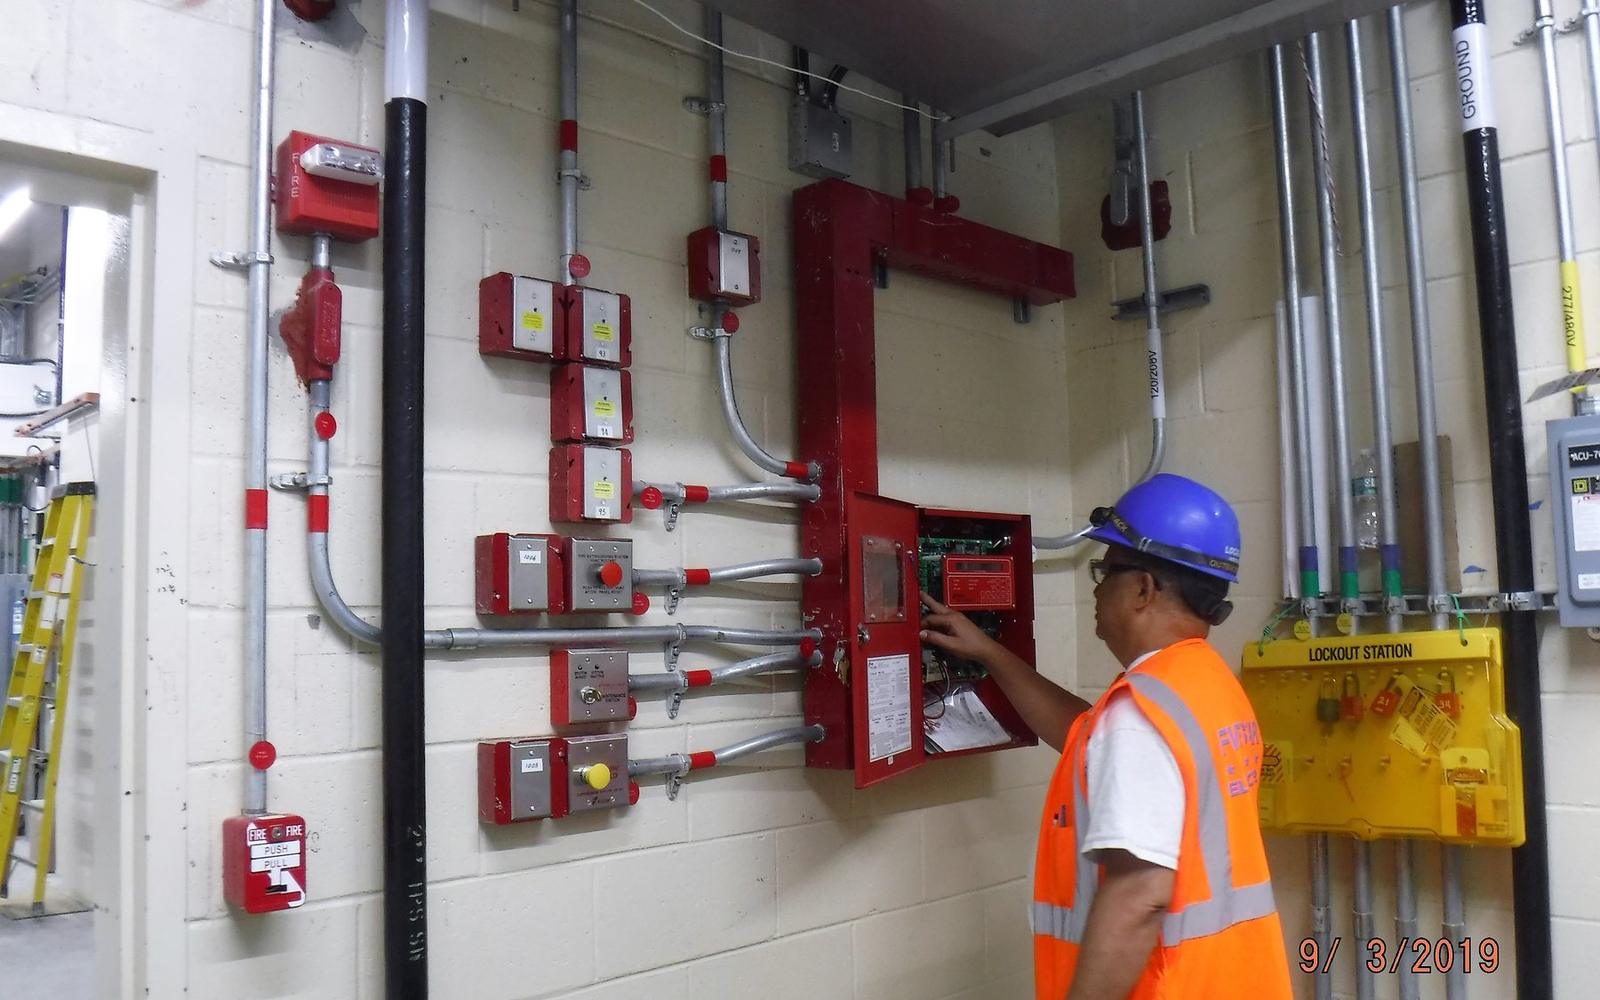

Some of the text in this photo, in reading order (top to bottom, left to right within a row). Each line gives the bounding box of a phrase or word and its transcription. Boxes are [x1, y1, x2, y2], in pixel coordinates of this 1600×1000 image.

[1456, 39, 1476, 119] GROUND
[291, 153, 300, 197] FIRE
[1562, 285, 1576, 347] 277/480V
[1148, 351, 1159, 399] 120/208V
[1573, 450, 1600, 461] ACU-7
[1309, 643, 1413, 662] LOCKOUT STATION
[249, 825, 303, 841] FIRE FIRE
[264, 845, 288, 855] PUSH
[264, 859, 288, 869] PULL
